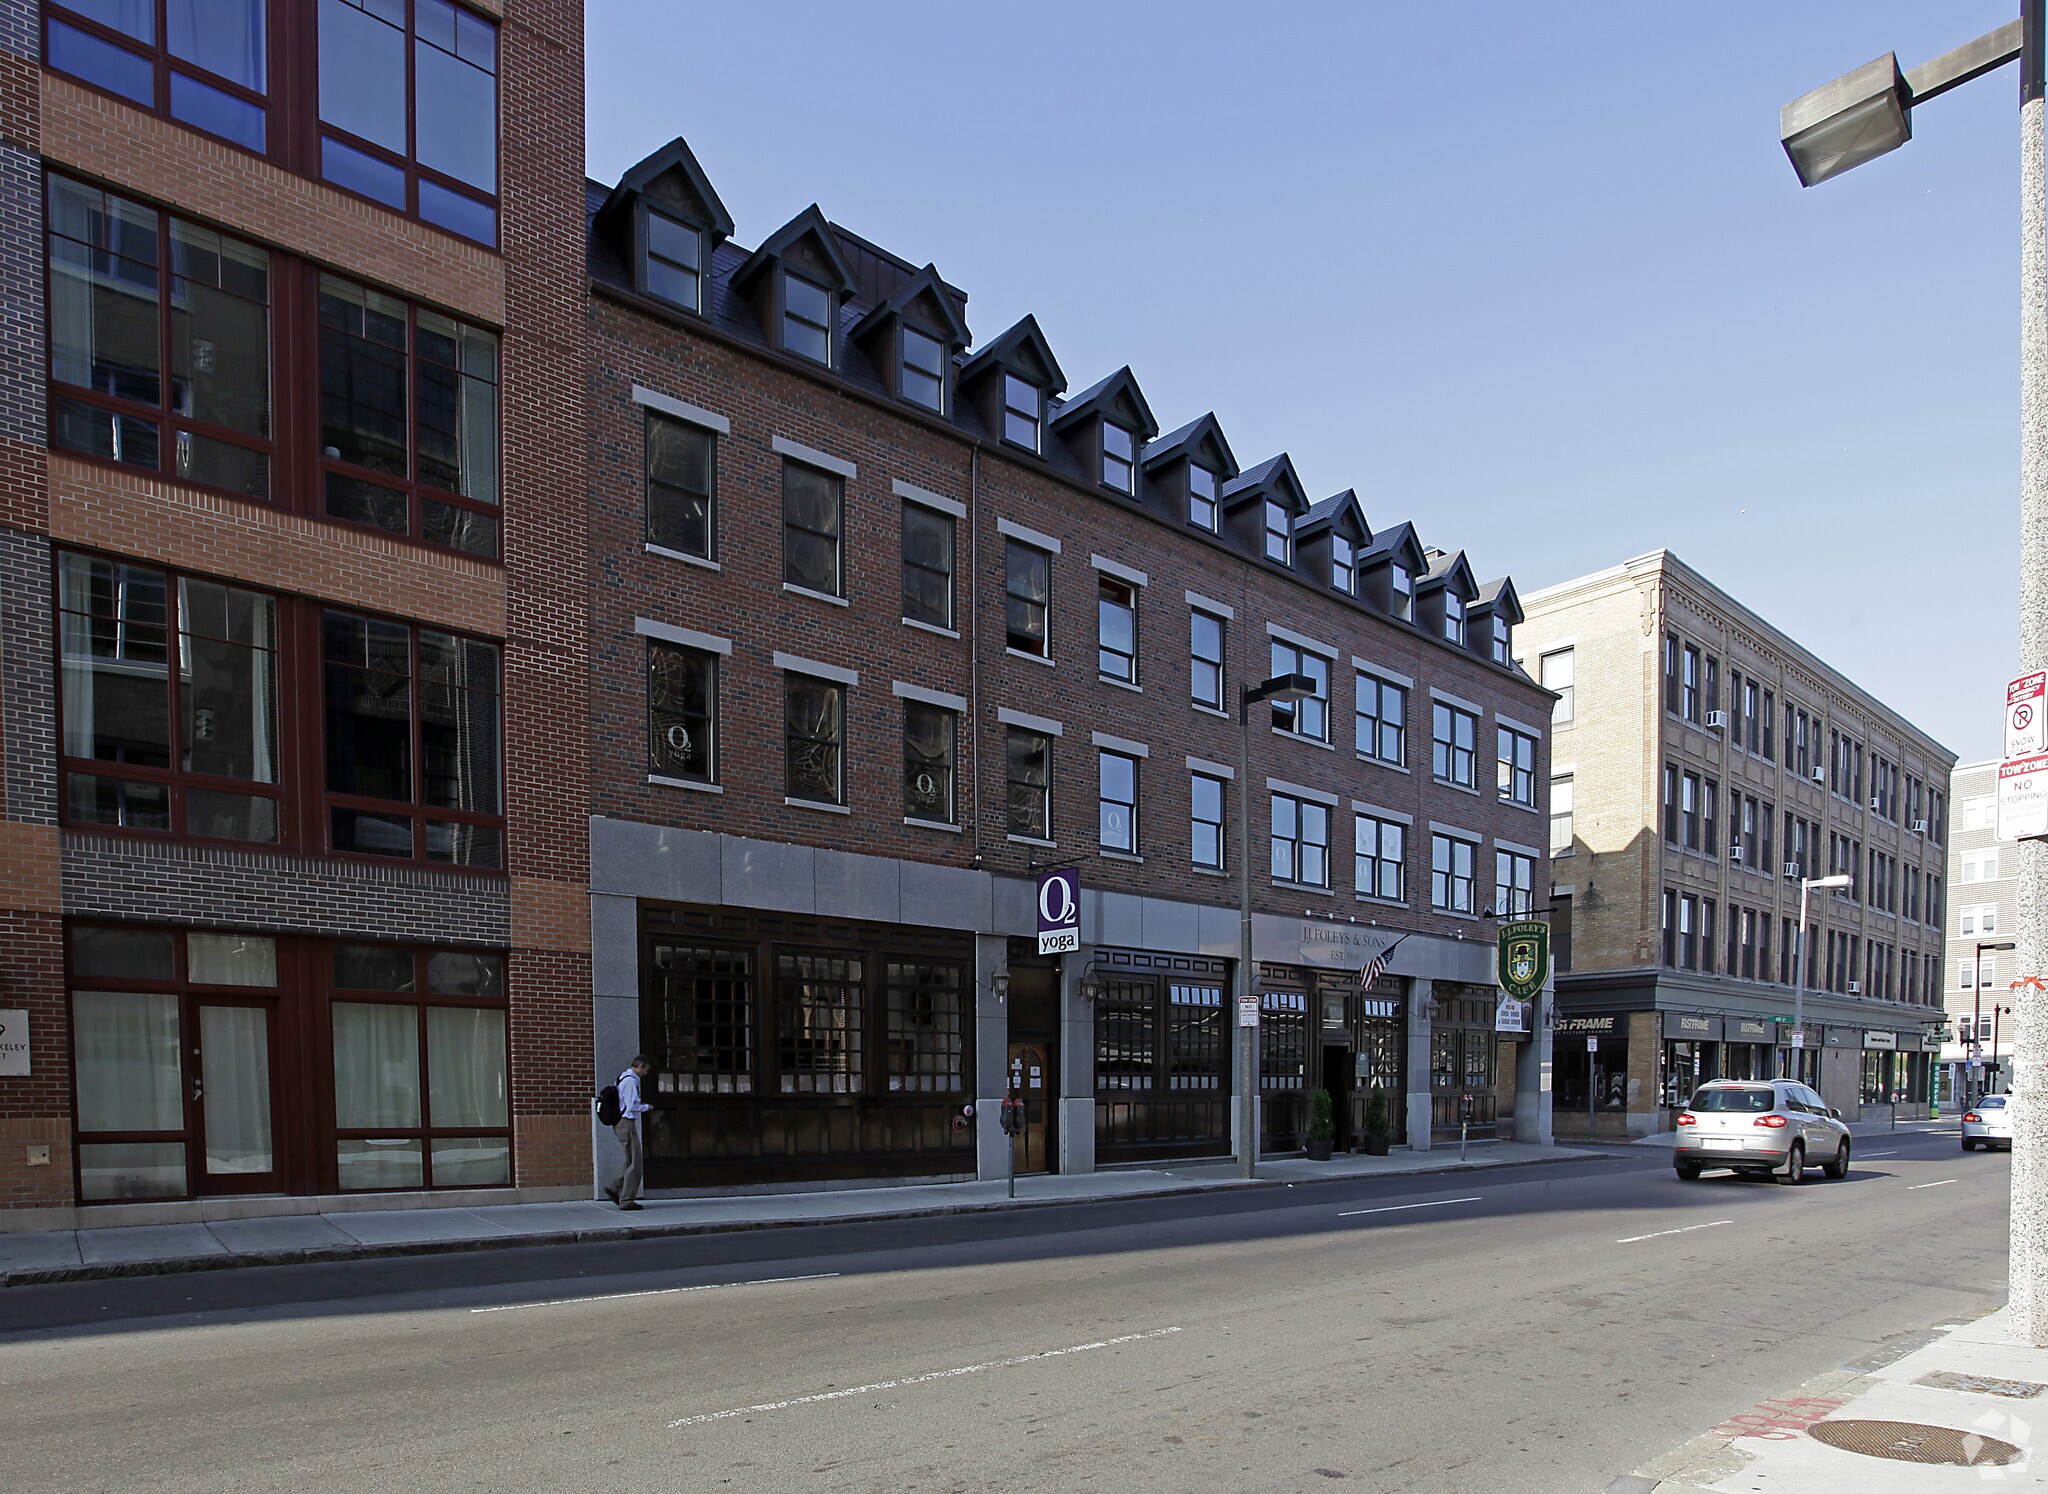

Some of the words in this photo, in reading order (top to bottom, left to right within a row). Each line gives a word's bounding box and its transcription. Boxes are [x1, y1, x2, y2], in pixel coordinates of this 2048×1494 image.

[2008, 682, 2020, 693] TOW
[2022, 674, 2045, 688] ZONE
[2001, 765, 2022, 777] TOW
[2014, 779, 2032, 791] NO
[2000, 791, 2047, 806] STOPPING
[1039, 876, 1076, 924] O2
[1041, 934, 1075, 953] yoga
[1353, 934, 1361, 947] &
[1363, 935, 1386, 949] SONS
[1681, 1018, 1709, 1031] FASTFRAME
